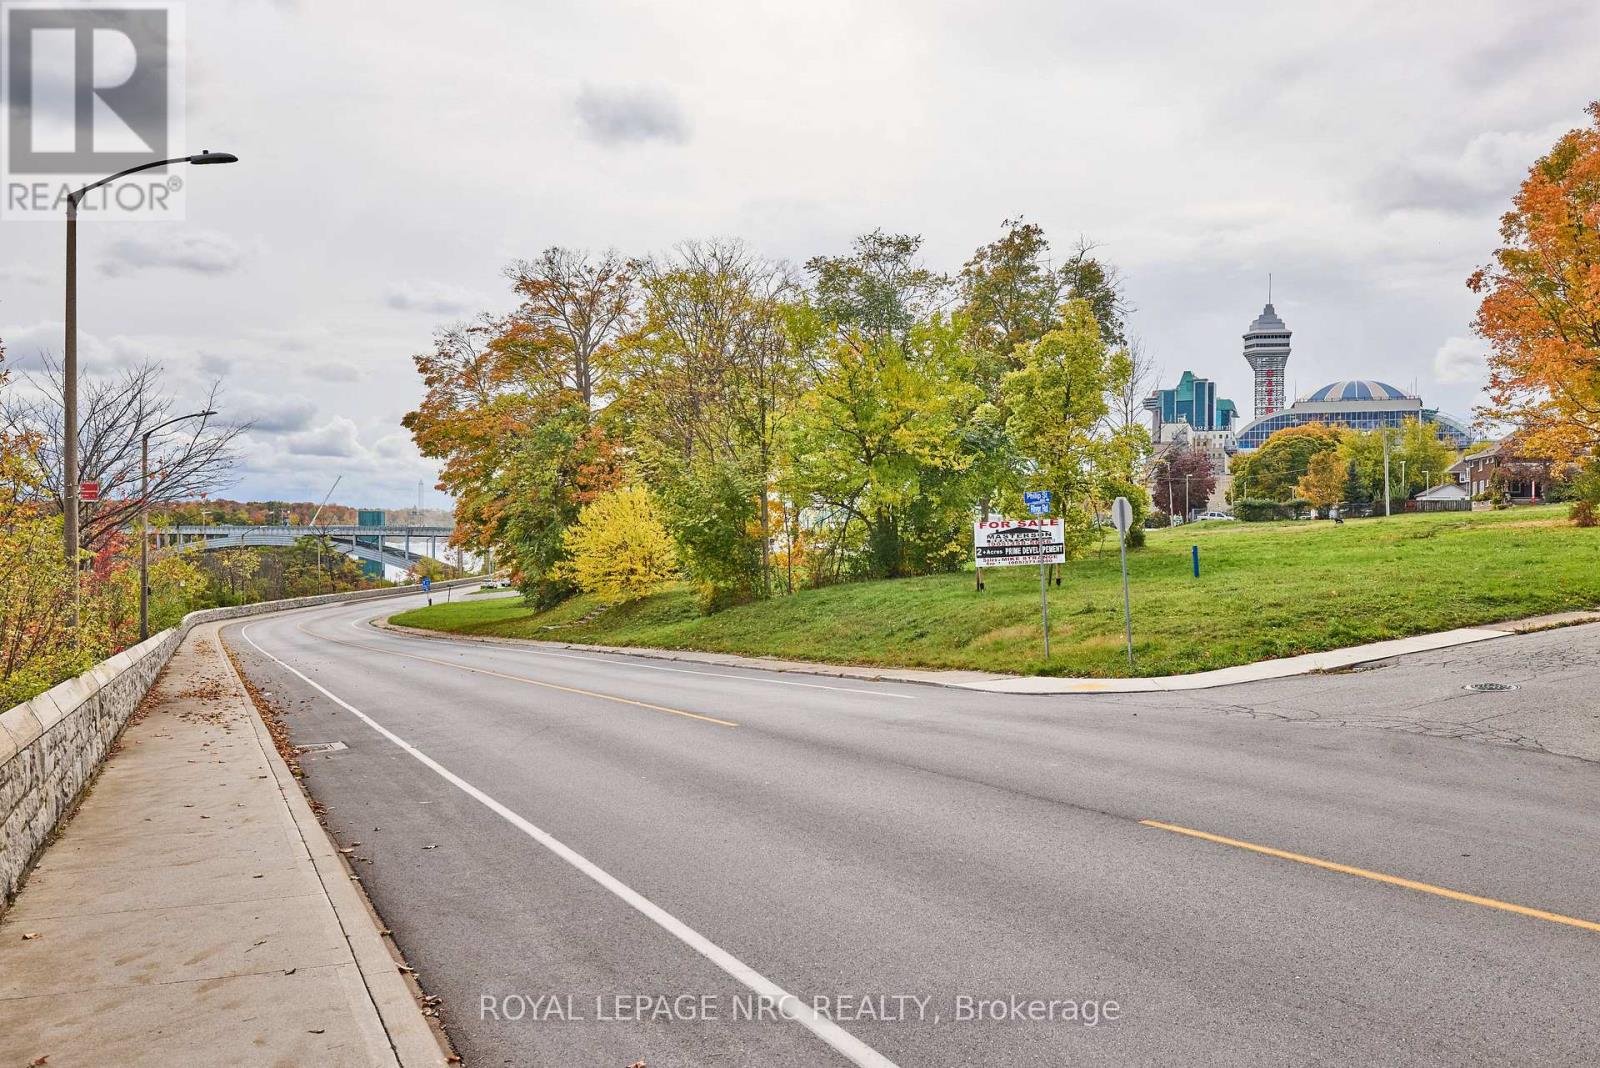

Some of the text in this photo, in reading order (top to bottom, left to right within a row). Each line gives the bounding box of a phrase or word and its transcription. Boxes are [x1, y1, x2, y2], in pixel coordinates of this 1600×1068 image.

[979, 519, 1059, 529] FOR SALE
[1005, 546, 1022, 555] PRIME
